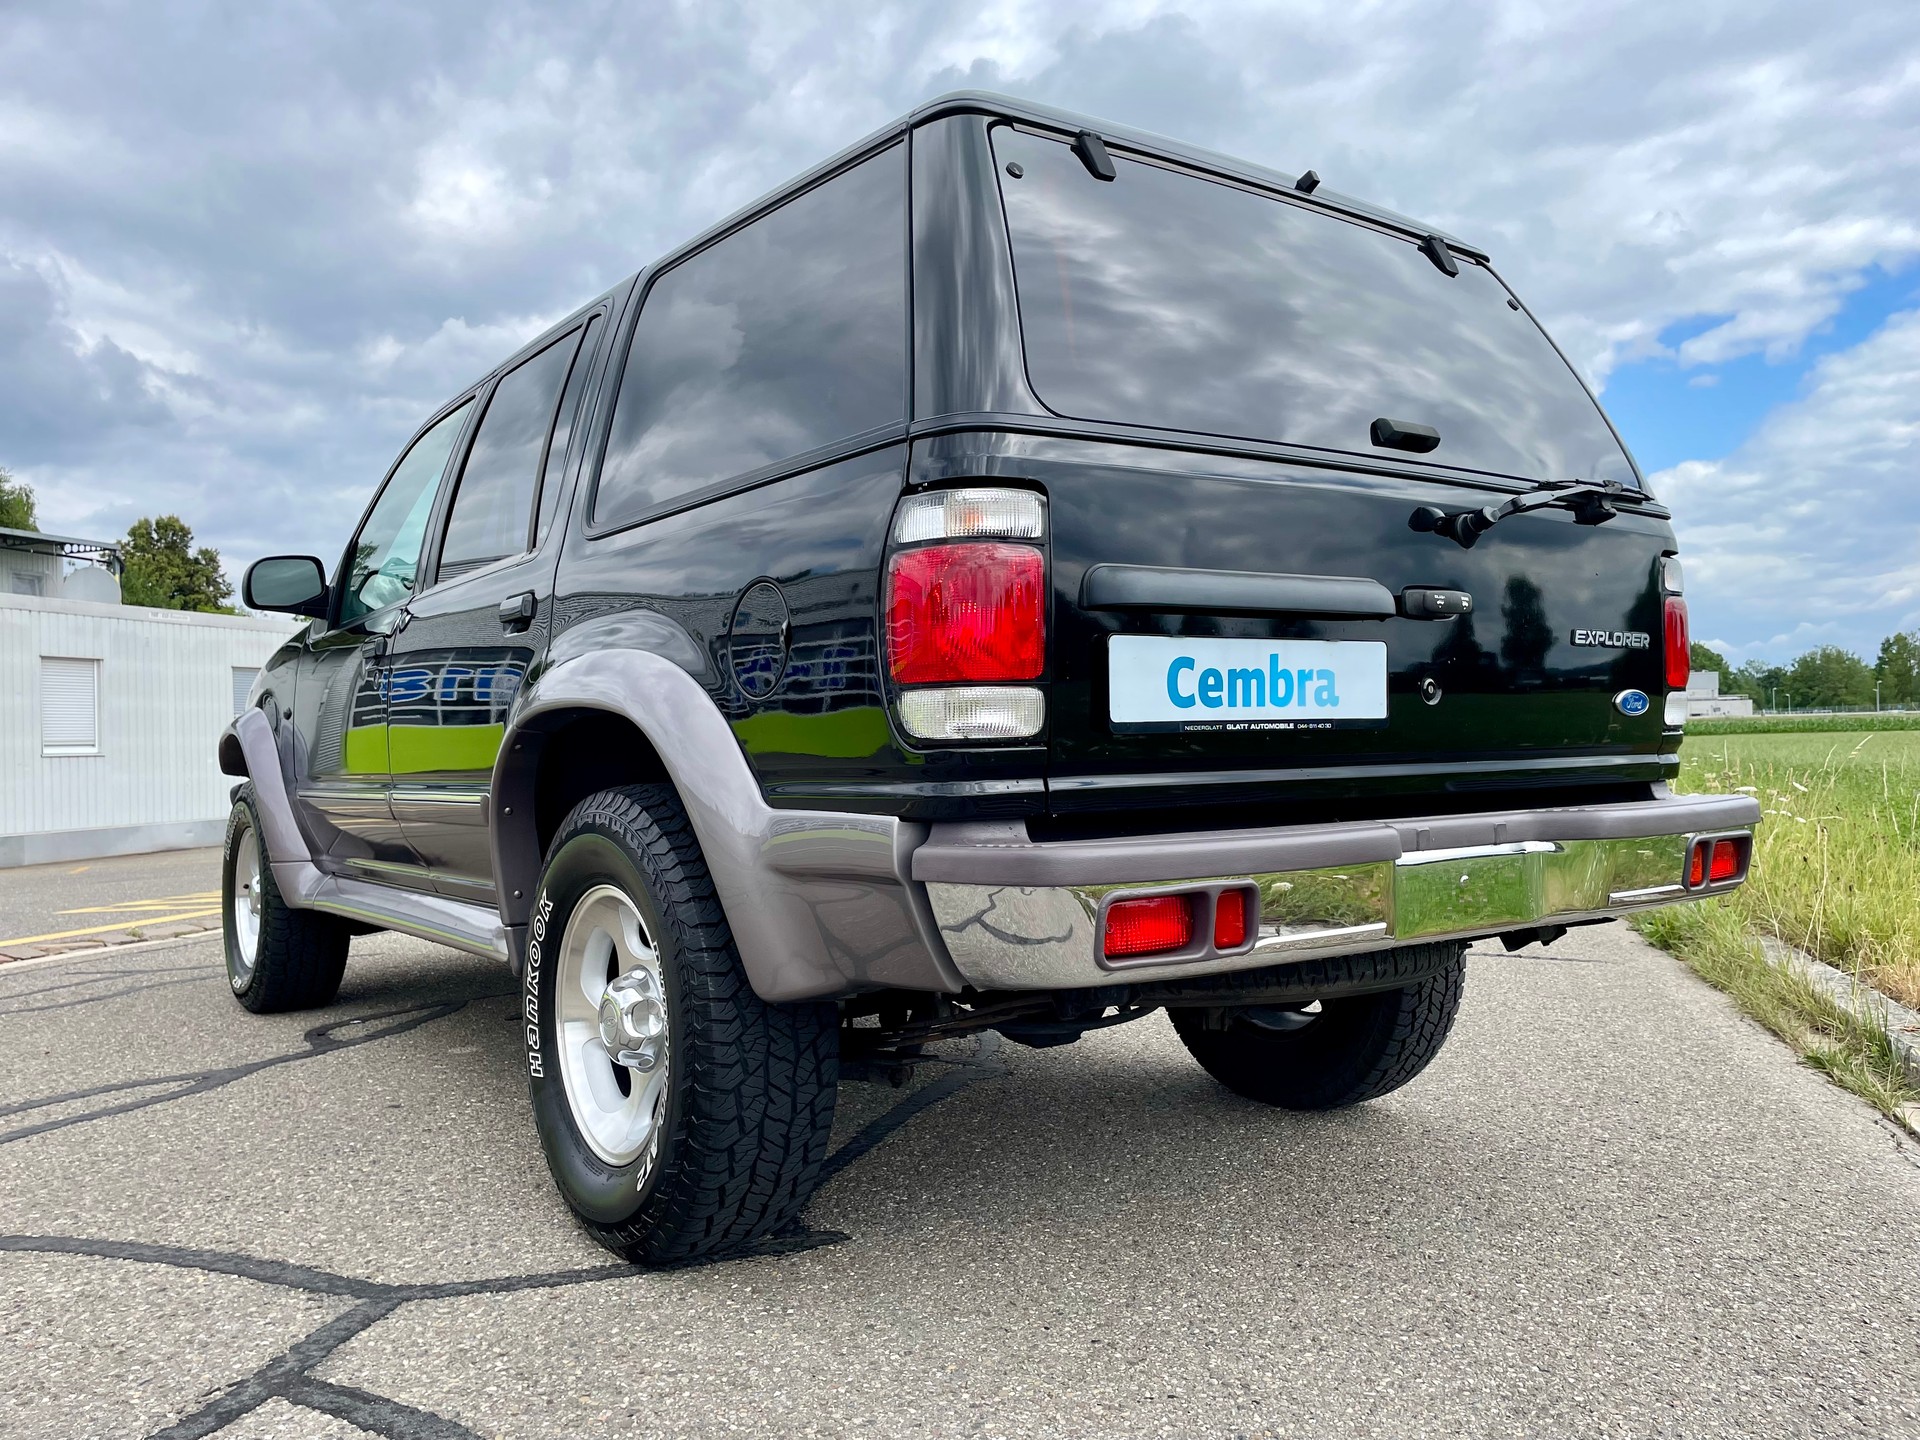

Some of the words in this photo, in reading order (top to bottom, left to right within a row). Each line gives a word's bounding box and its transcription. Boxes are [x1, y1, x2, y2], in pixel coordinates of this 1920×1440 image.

[1574, 629, 1650, 648] EXPLORER
[1166, 653, 1340, 709] Cembra
[1625, 694, 1643, 709] Ford
[1250, 722, 1295, 730] AUTOMOBILE
